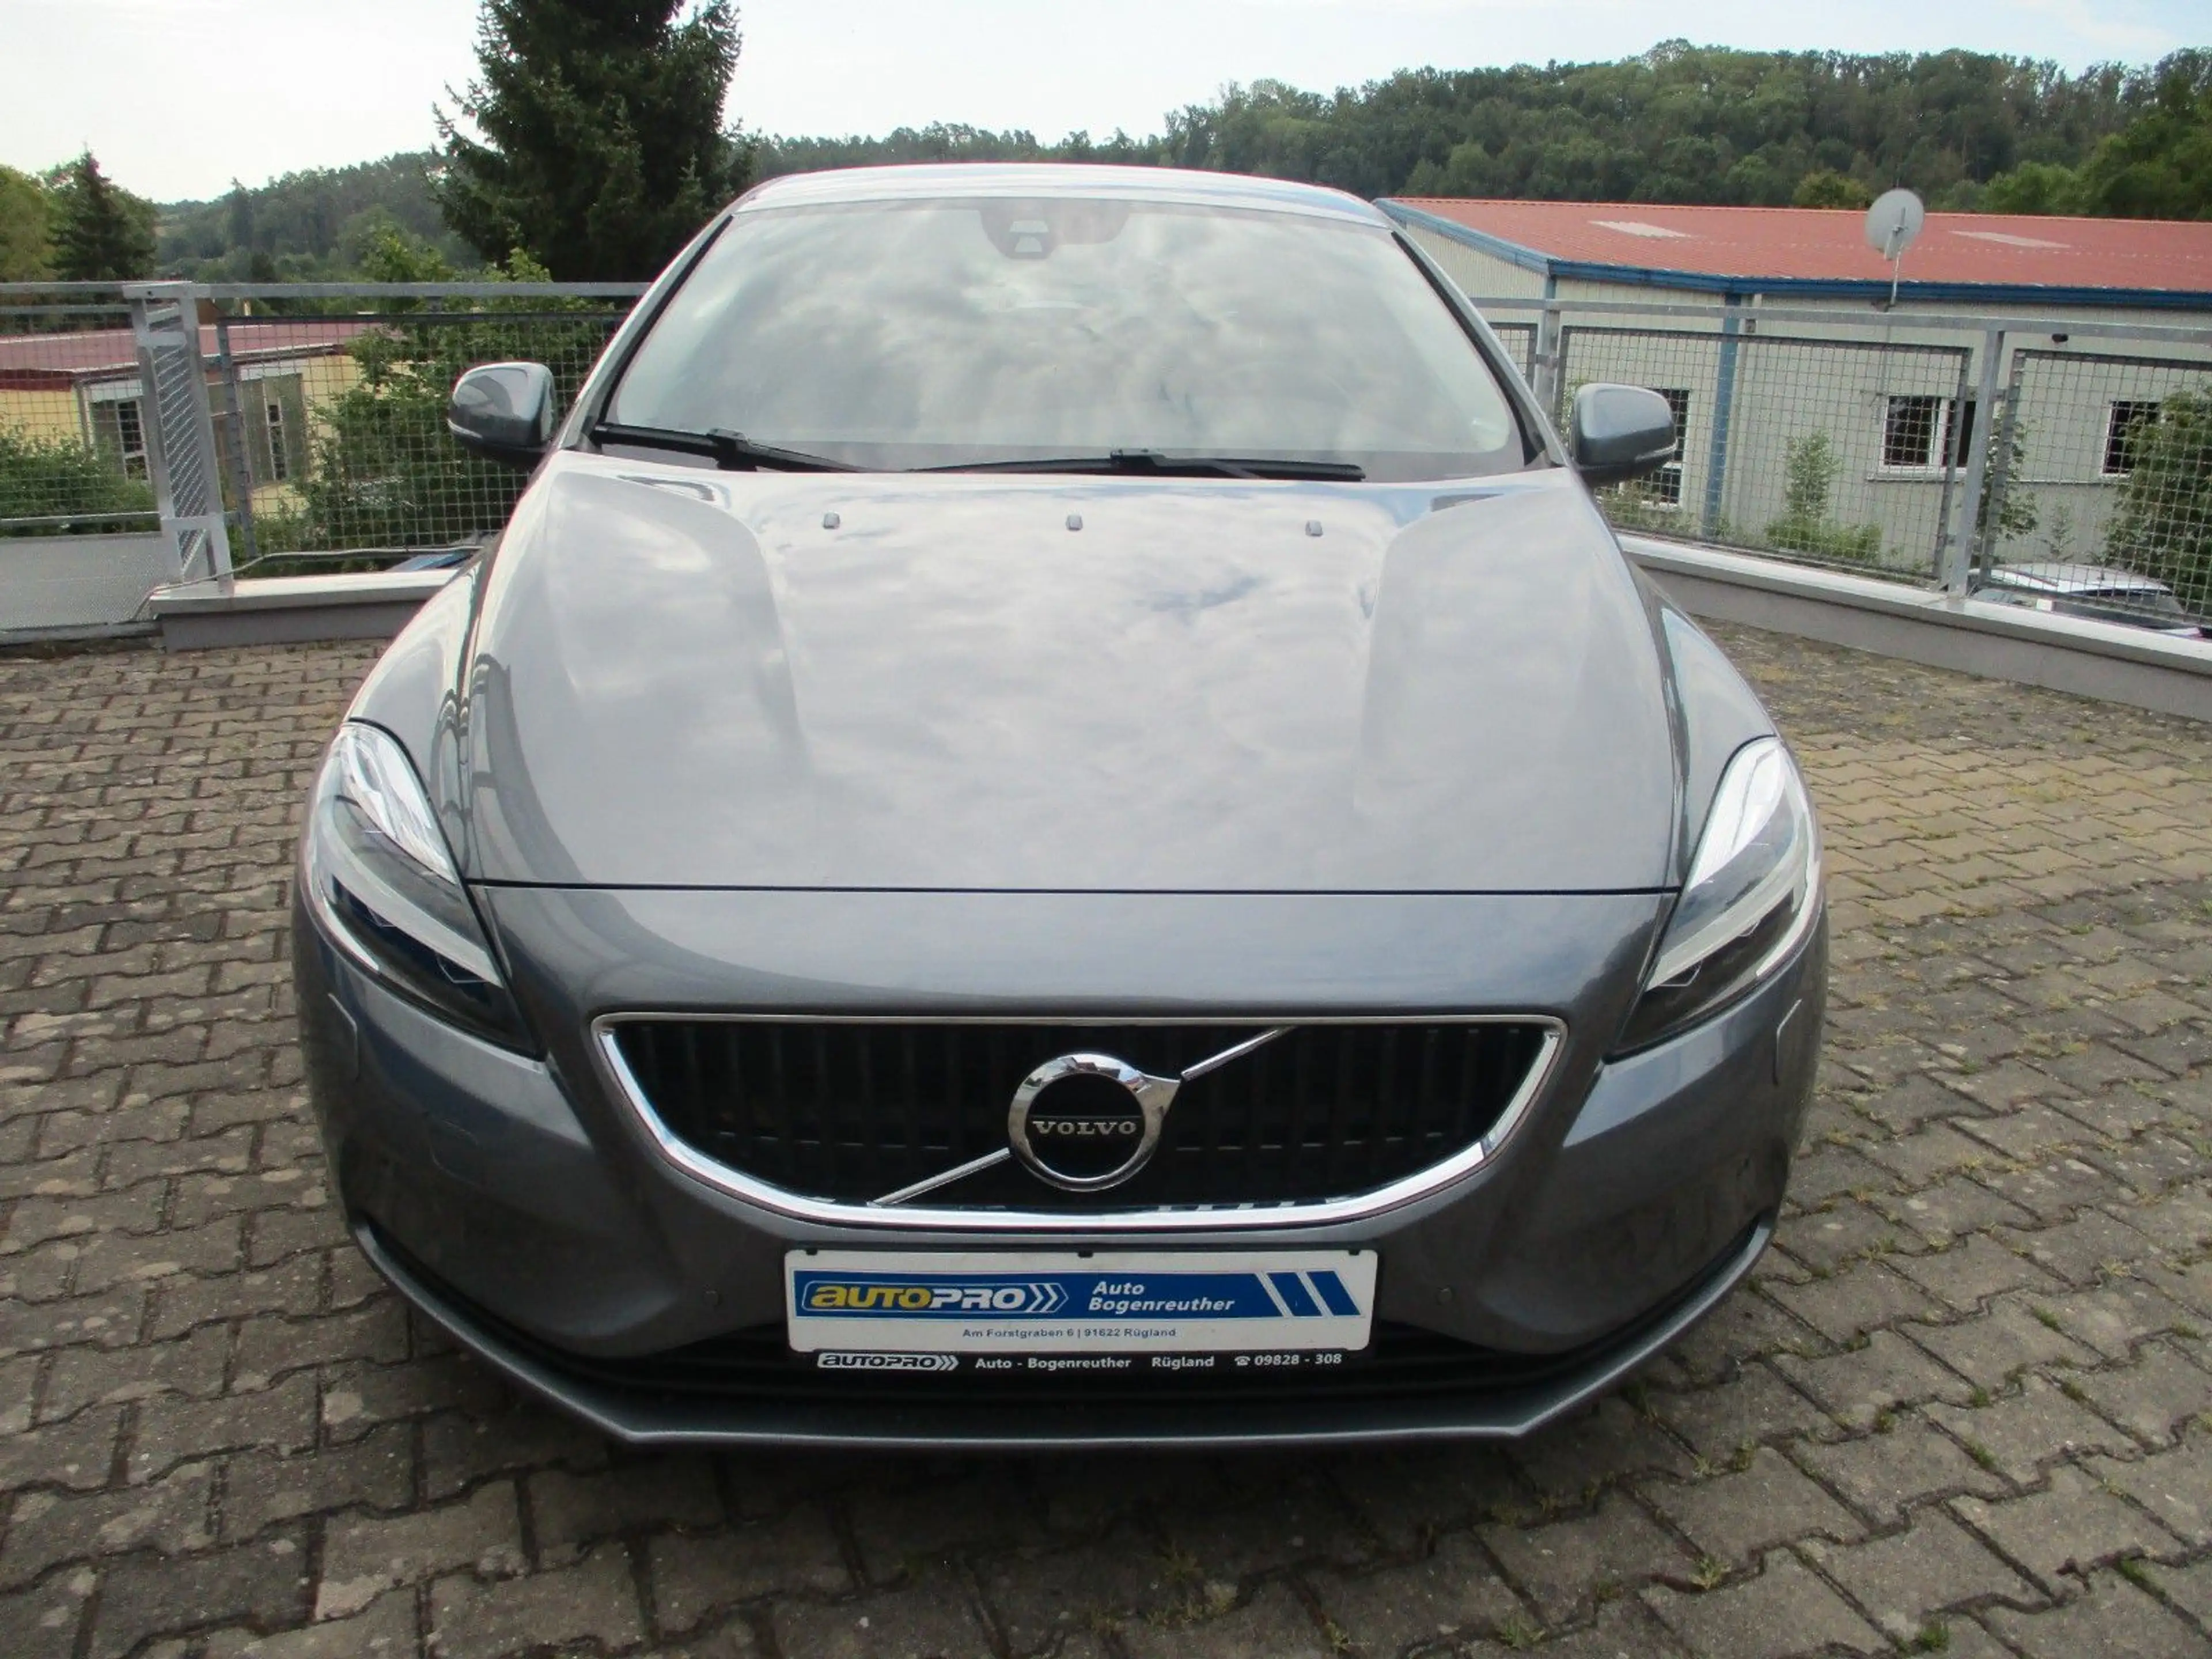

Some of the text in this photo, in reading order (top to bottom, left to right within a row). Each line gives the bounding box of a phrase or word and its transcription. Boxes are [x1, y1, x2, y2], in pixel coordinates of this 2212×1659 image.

[1033, 1121, 1137, 1135] VOLVO
[1093, 1281, 1145, 1296] Auto
[1089, 1297, 1235, 1315] Bogenreuther
[963, 1329, 982, 1338] Am
[986, 1328, 1063, 1339] Forstgraben
[1085, 1328, 1120, 1337] 91622
[1124, 1328, 1176, 1339] Rügland
[975, 1358, 1013, 1369] Auto
[1028, 1357, 1132, 1371] Bogenreuther
[1152, 1355, 1215, 1369] Rügland
[1254, 1354, 1300, 1365] 09828
[1316, 1354, 1342, 1364] 308
